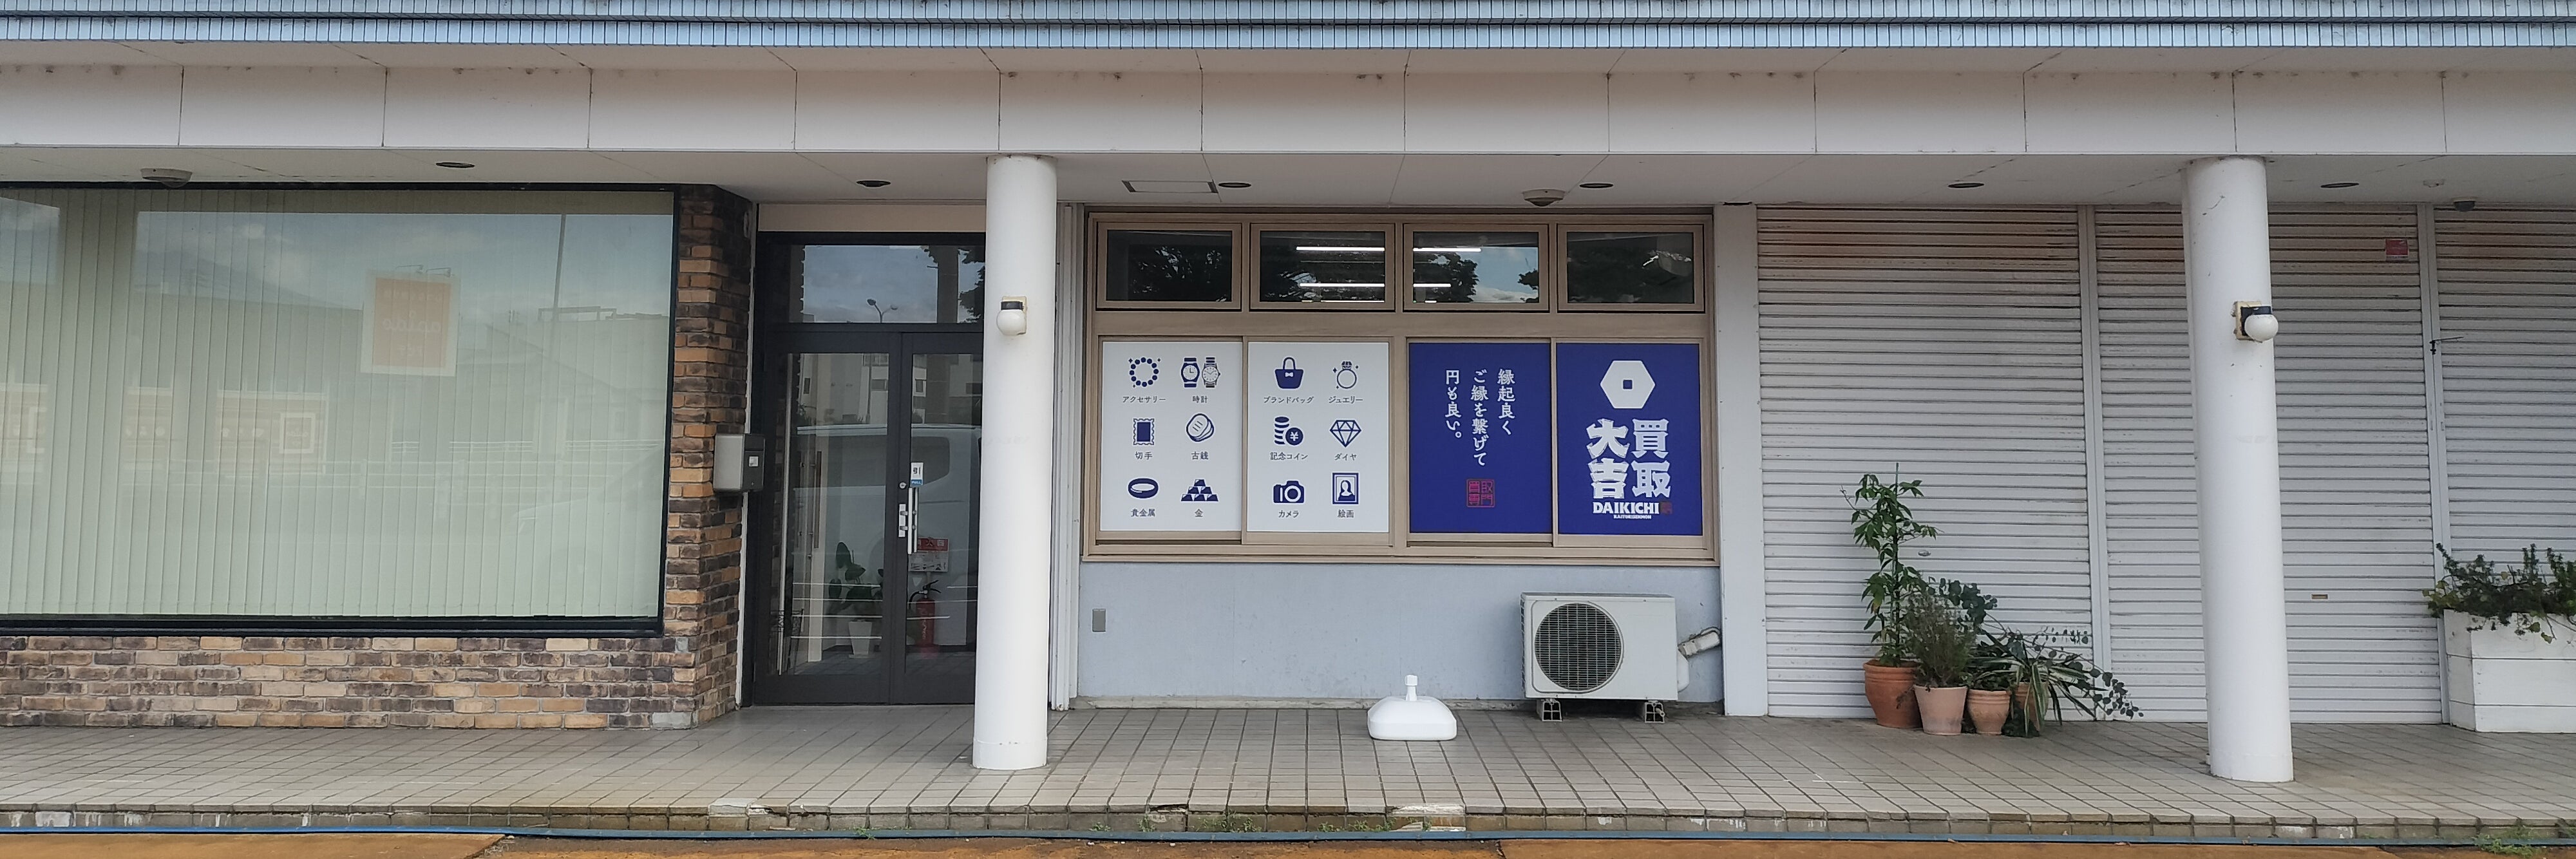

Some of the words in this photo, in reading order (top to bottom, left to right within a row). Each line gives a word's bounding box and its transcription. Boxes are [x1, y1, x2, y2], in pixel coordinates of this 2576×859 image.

[1192, 395, 1208, 404] 時計
[1264, 395, 1314, 404] ブランドバッグ
[1329, 395, 1363, 404] ジュエリー
[1497, 368, 1516, 435] 縁起良く
[1444, 370, 1462, 439] 円も良い。
[1470, 369, 1490, 466] ご縁を繋げて
[1135, 451, 1153, 460] 切手
[1191, 451, 1209, 460] 古銭
[1269, 451, 1309, 460] 記念コイン
[1334, 453, 1357, 461] ダイヤ
[1586, 418, 1631, 499] 大吉
[1631, 418, 1671, 498] 買取
[1593, 502, 1660, 514] DAIKICHI
[1130, 508, 1155, 518] 貴金属
[1194, 508, 1203, 518] 金
[1278, 509, 1299, 518] カメラ
[1337, 509, 1354, 518] 絵画
